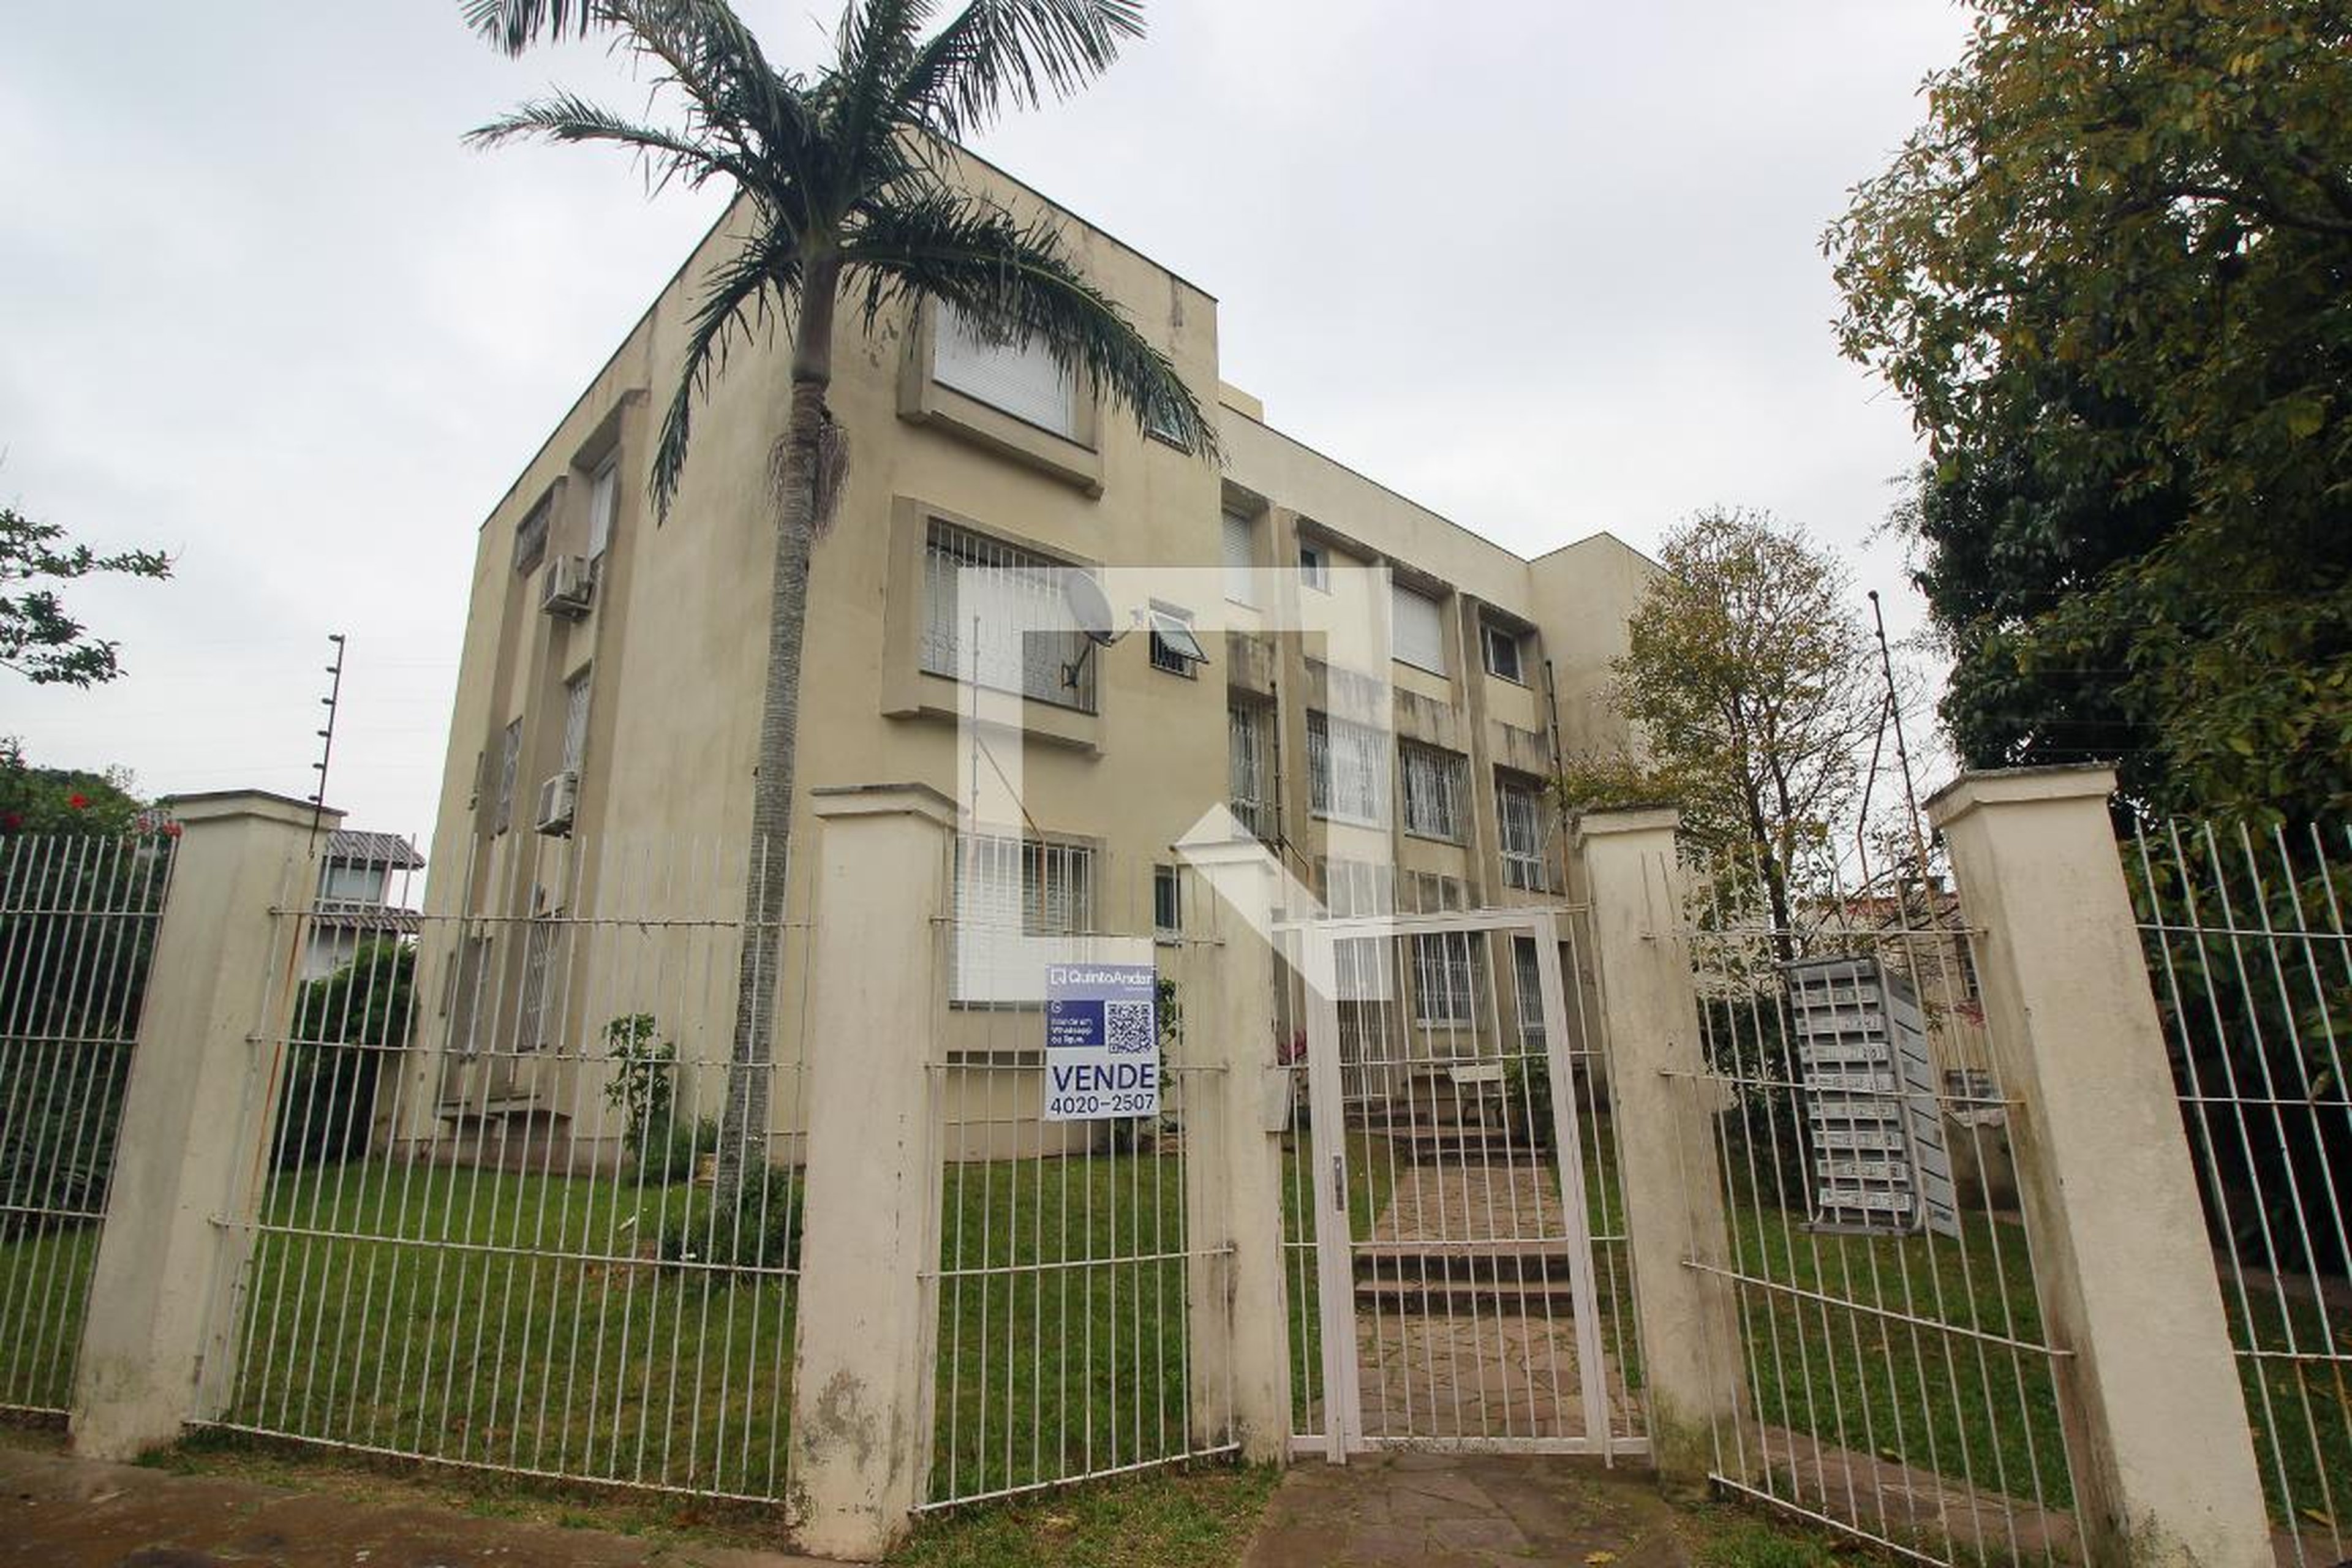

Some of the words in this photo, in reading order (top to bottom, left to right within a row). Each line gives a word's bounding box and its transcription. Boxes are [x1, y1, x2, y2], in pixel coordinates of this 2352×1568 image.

[1068, 969, 1153, 985] QuintoAndar
[1052, 1063, 1155, 1092] VENDE
[1050, 1093, 1155, 1114] 4020-2507
